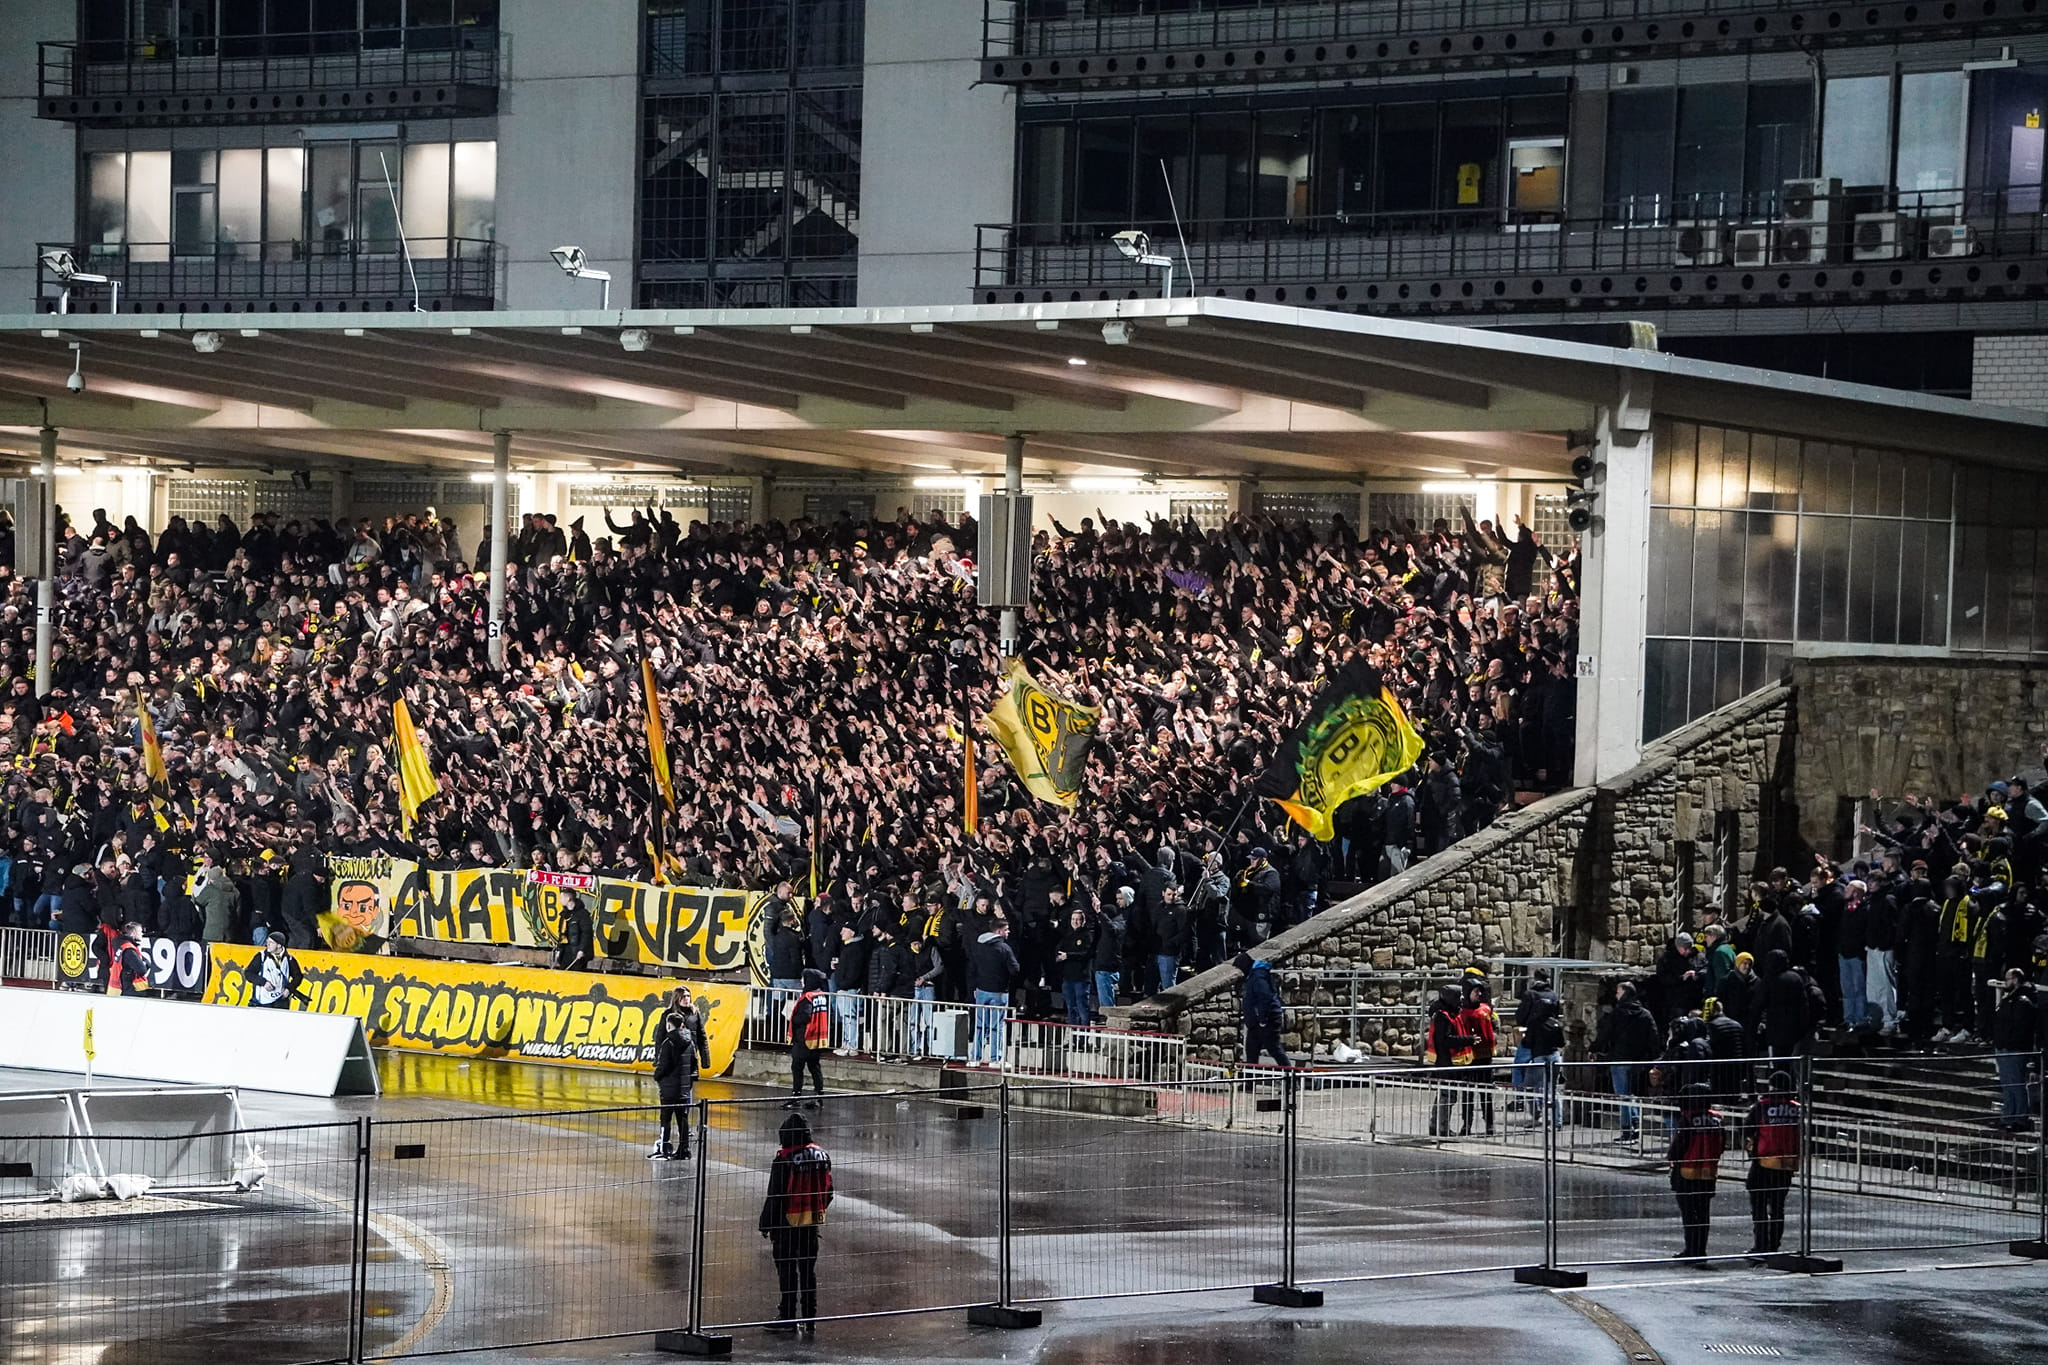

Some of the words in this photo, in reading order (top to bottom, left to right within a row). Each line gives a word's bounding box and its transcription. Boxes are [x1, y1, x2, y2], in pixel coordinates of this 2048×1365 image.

[551, 875, 560, 885] FC
[379, 983, 666, 1047] STADIONVERBO
[521, 1040, 573, 1058] NIEMALS
[576, 1043, 637, 1061] VERZAGEN
